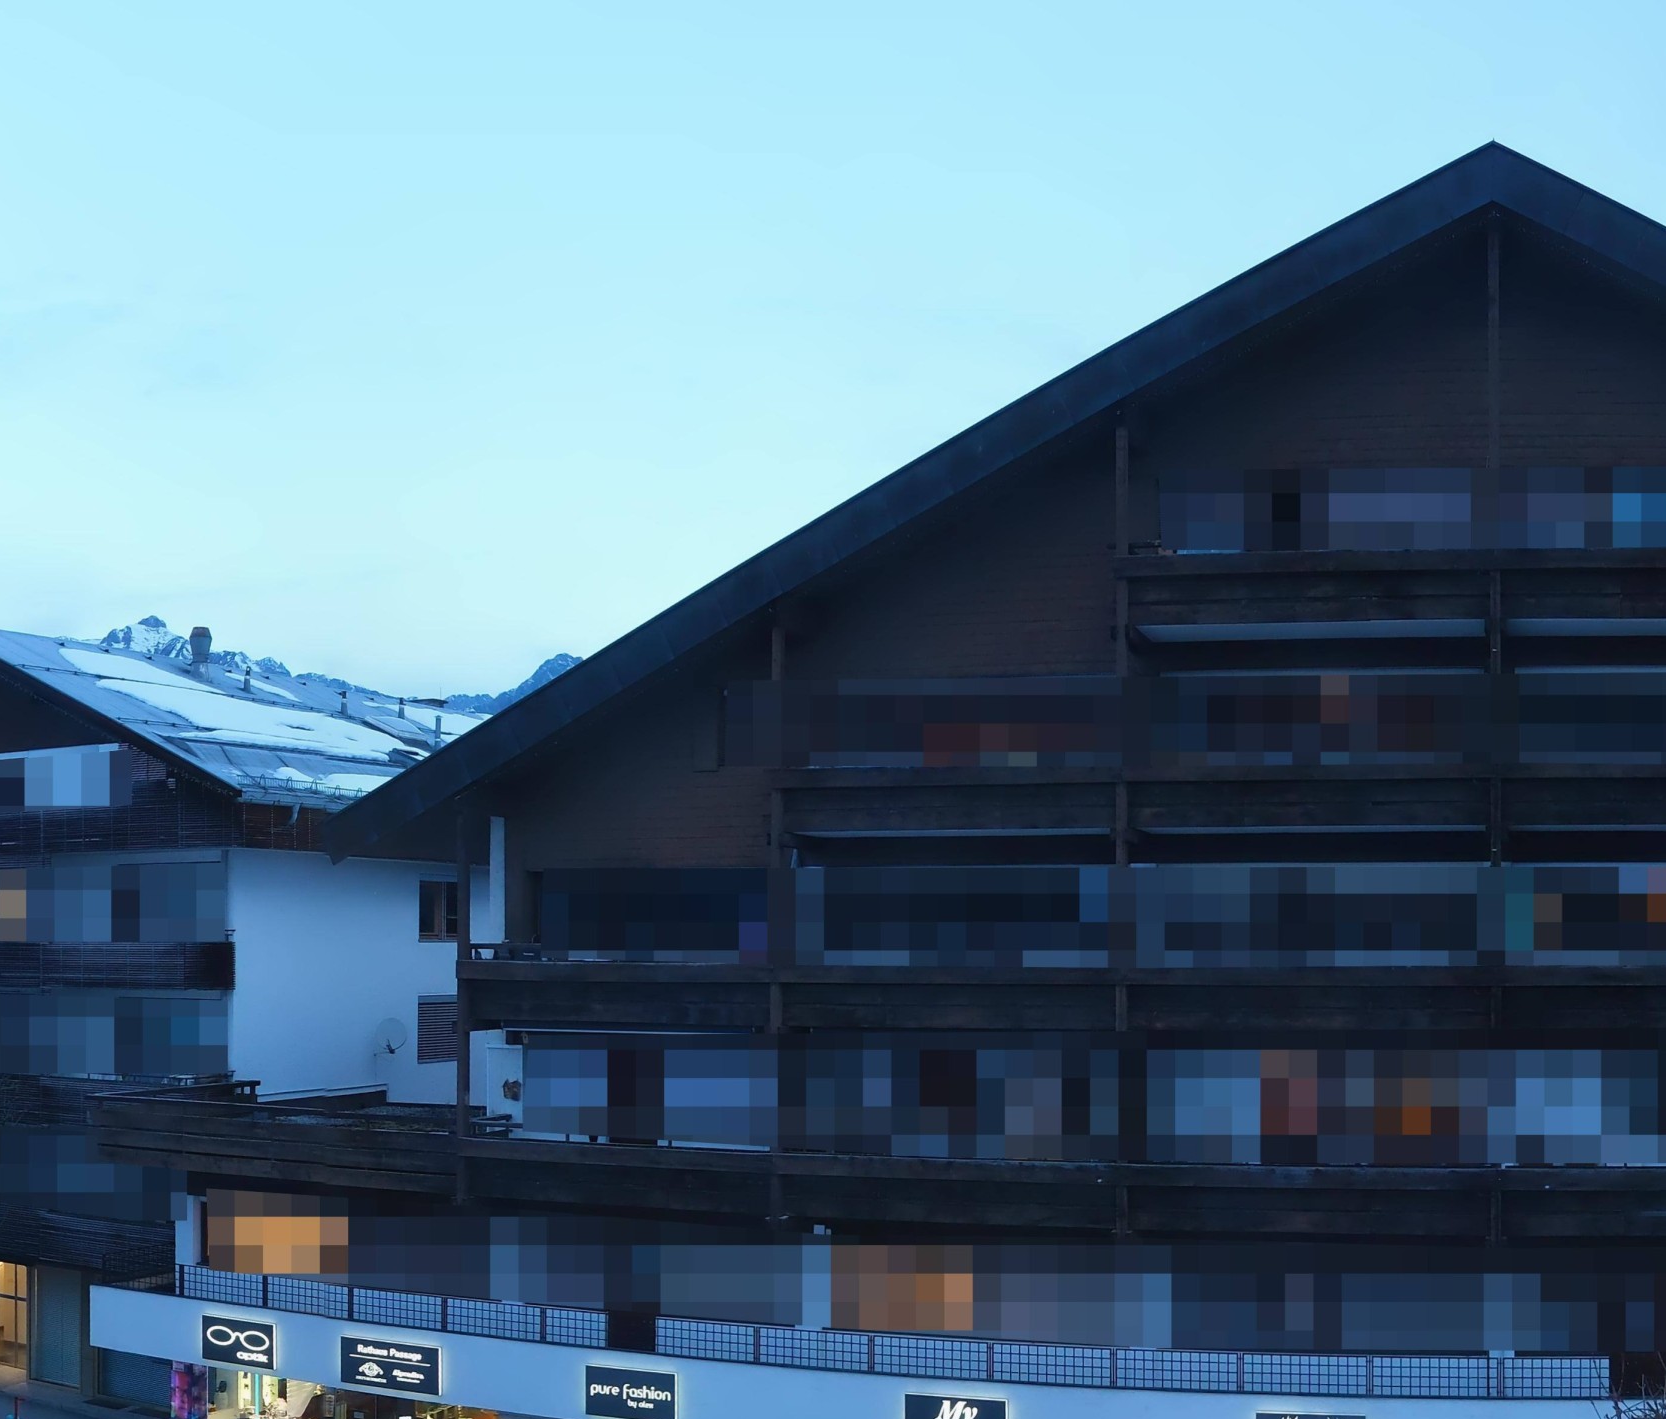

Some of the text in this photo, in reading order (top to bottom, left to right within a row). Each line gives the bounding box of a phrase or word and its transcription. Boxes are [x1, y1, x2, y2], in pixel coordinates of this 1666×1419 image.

[236, 1350, 269, 1364] optik
[590, 1383, 672, 1402] pure fashion
